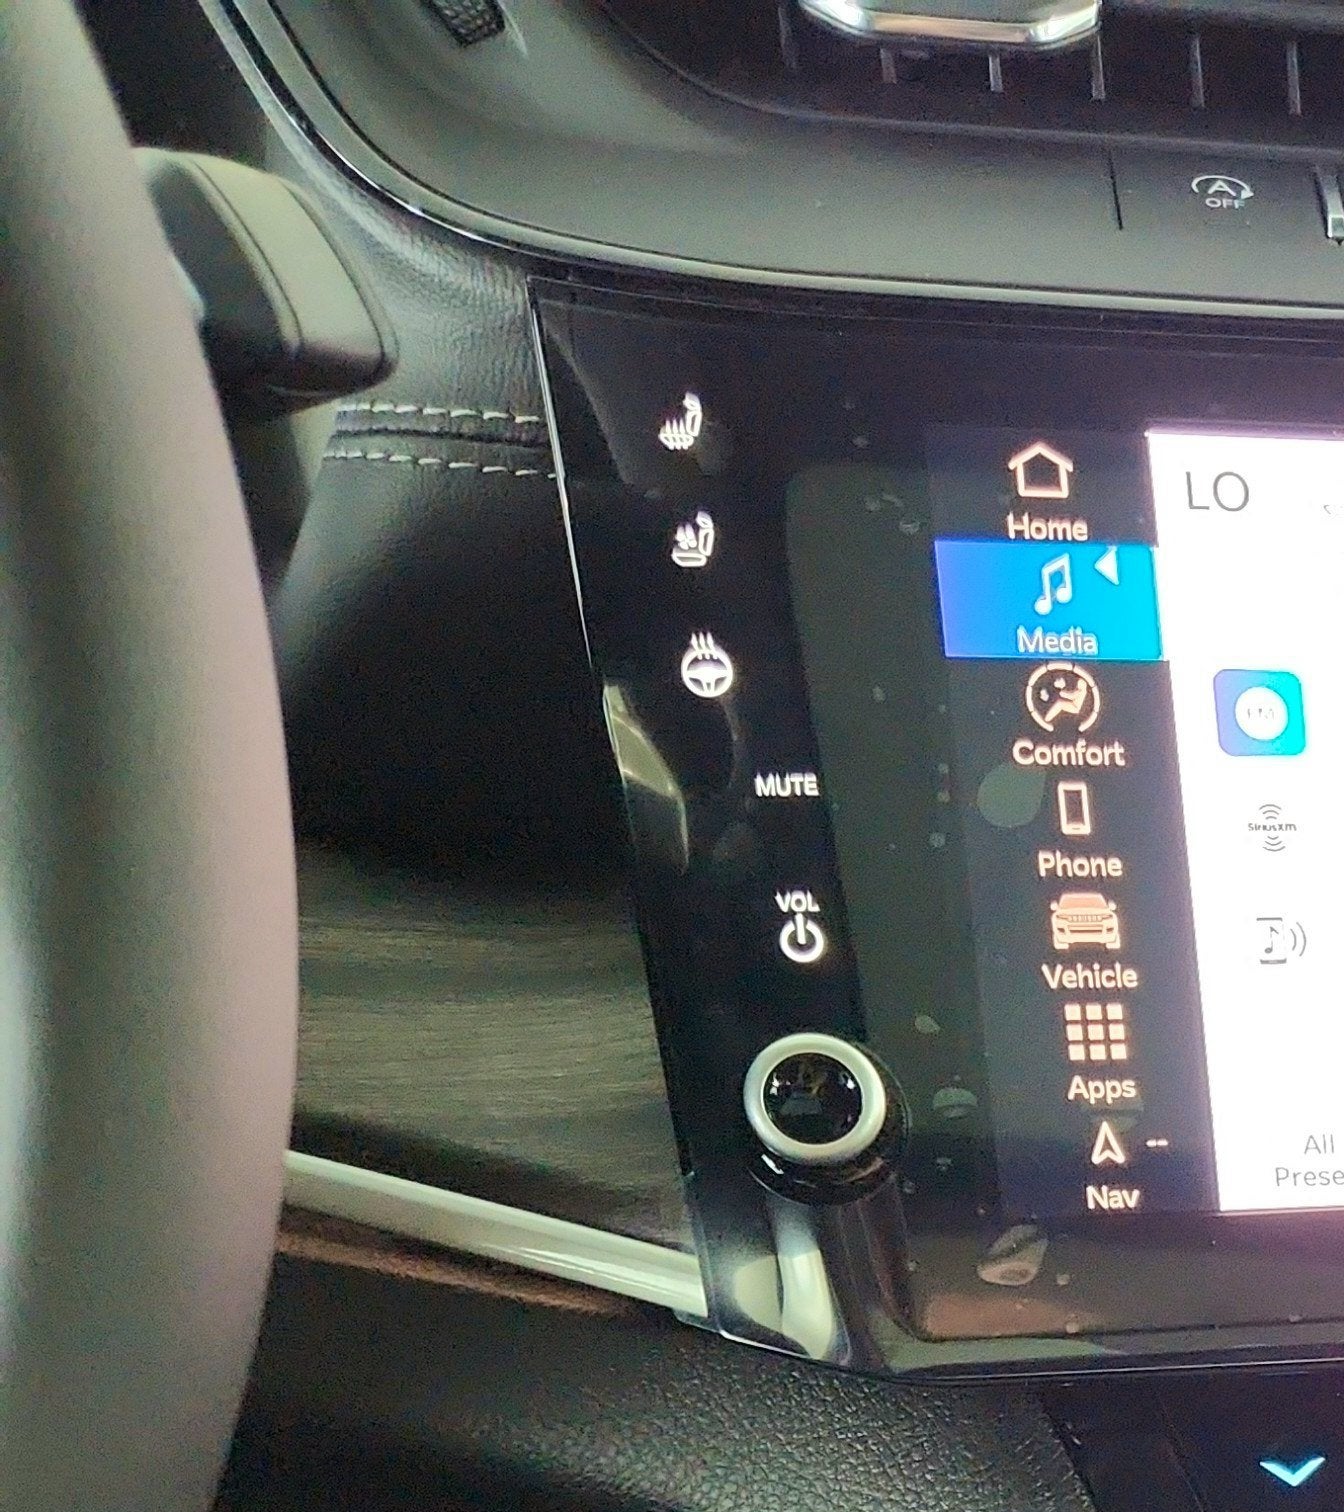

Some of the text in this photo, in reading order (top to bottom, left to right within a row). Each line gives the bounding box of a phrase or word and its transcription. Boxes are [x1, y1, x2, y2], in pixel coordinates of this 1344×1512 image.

[1205, 197, 1246, 209] OFF
[1186, 471, 1250, 512] LO
[1007, 514, 1089, 541] Home
[1017, 626, 1099, 656] Media
[1013, 738, 1126, 767] Comfort
[754, 772, 820, 797] MUTE
[1038, 849, 1123, 878] Phone
[774, 890, 821, 912] VOL
[1042, 962, 1139, 989] Vehicle
[1067, 1074, 1137, 1105] Apps
[1303, 1133, 1335, 1155] All
[1085, 1184, 1141, 1210] Nav
